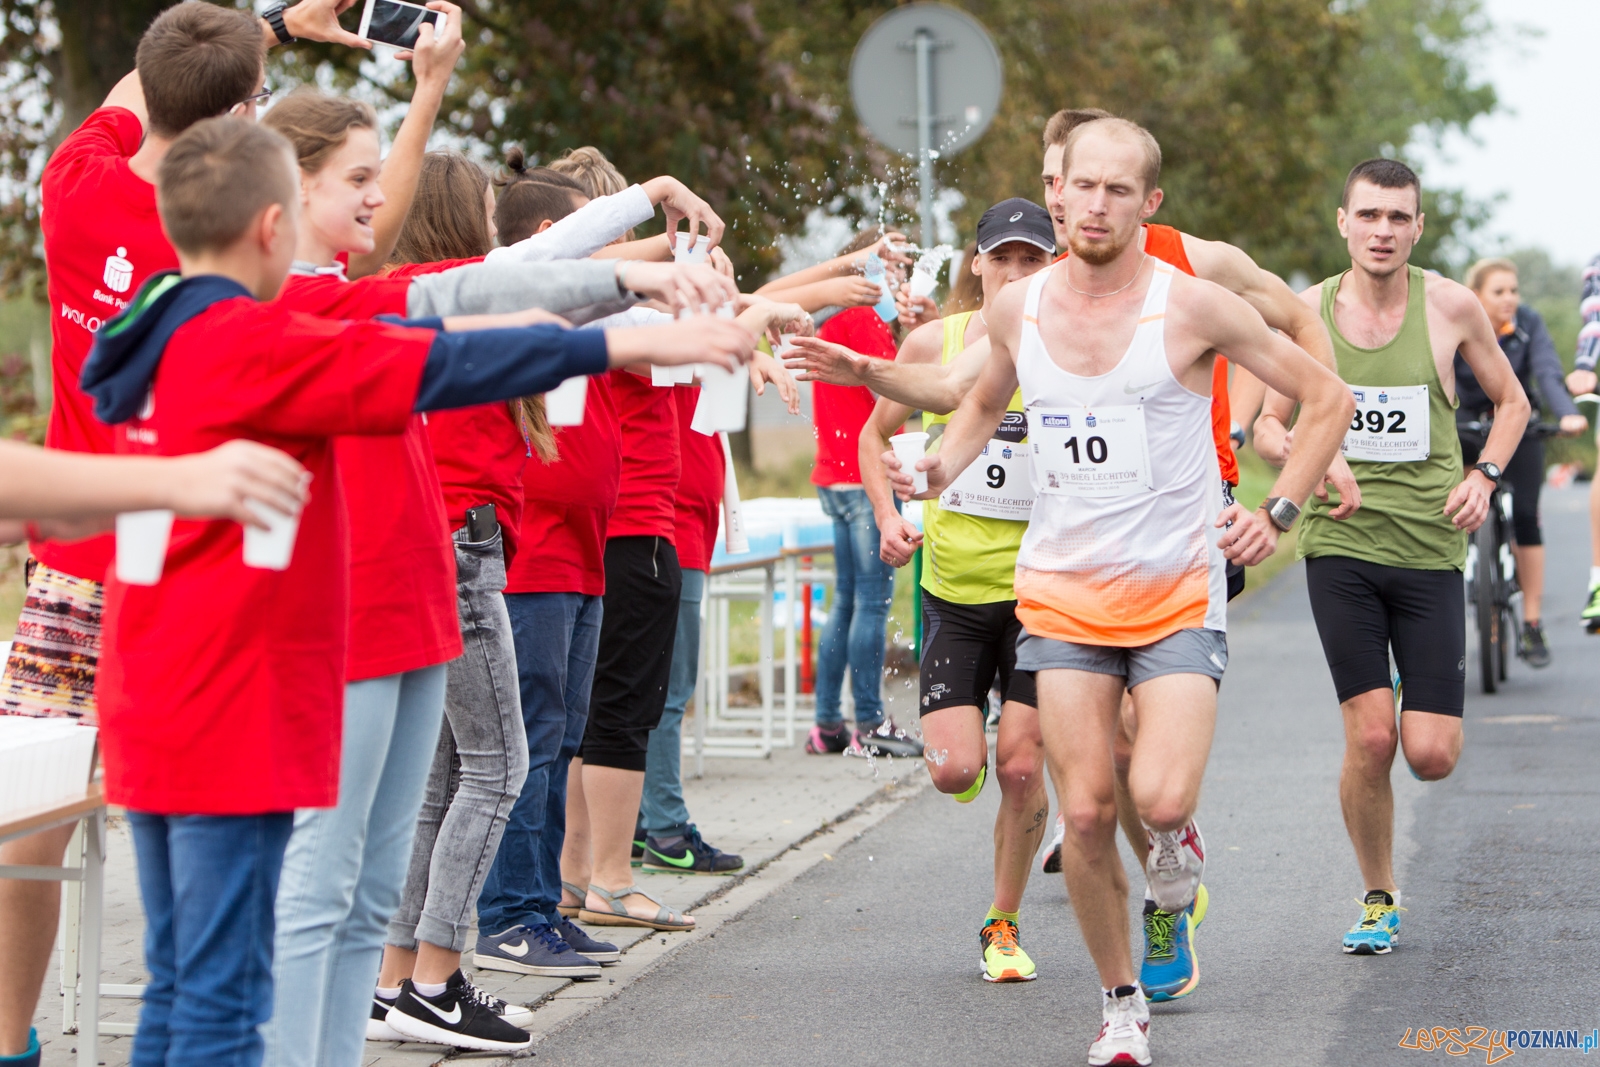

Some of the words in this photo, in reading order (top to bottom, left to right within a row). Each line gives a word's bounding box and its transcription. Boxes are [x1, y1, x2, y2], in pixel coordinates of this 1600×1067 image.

[93, 289, 115, 305] Bank
[61, 302, 106, 333] WOLO
[1350, 409, 1407, 433] 392
[1064, 436, 1108, 464] 10
[1350, 438, 1359, 446] 39
[1360, 439, 1378, 447] BIEG
[1379, 439, 1419, 448] LECHITÓW
[986, 464, 1006, 489] 9
[1059, 472, 1069, 481] 39
[1071, 473, 1090, 481] BIEG
[1092, 469, 1139, 481] LECHITÓW
[964, 492, 975, 501] 39
[976, 494, 996, 504] BIEG
